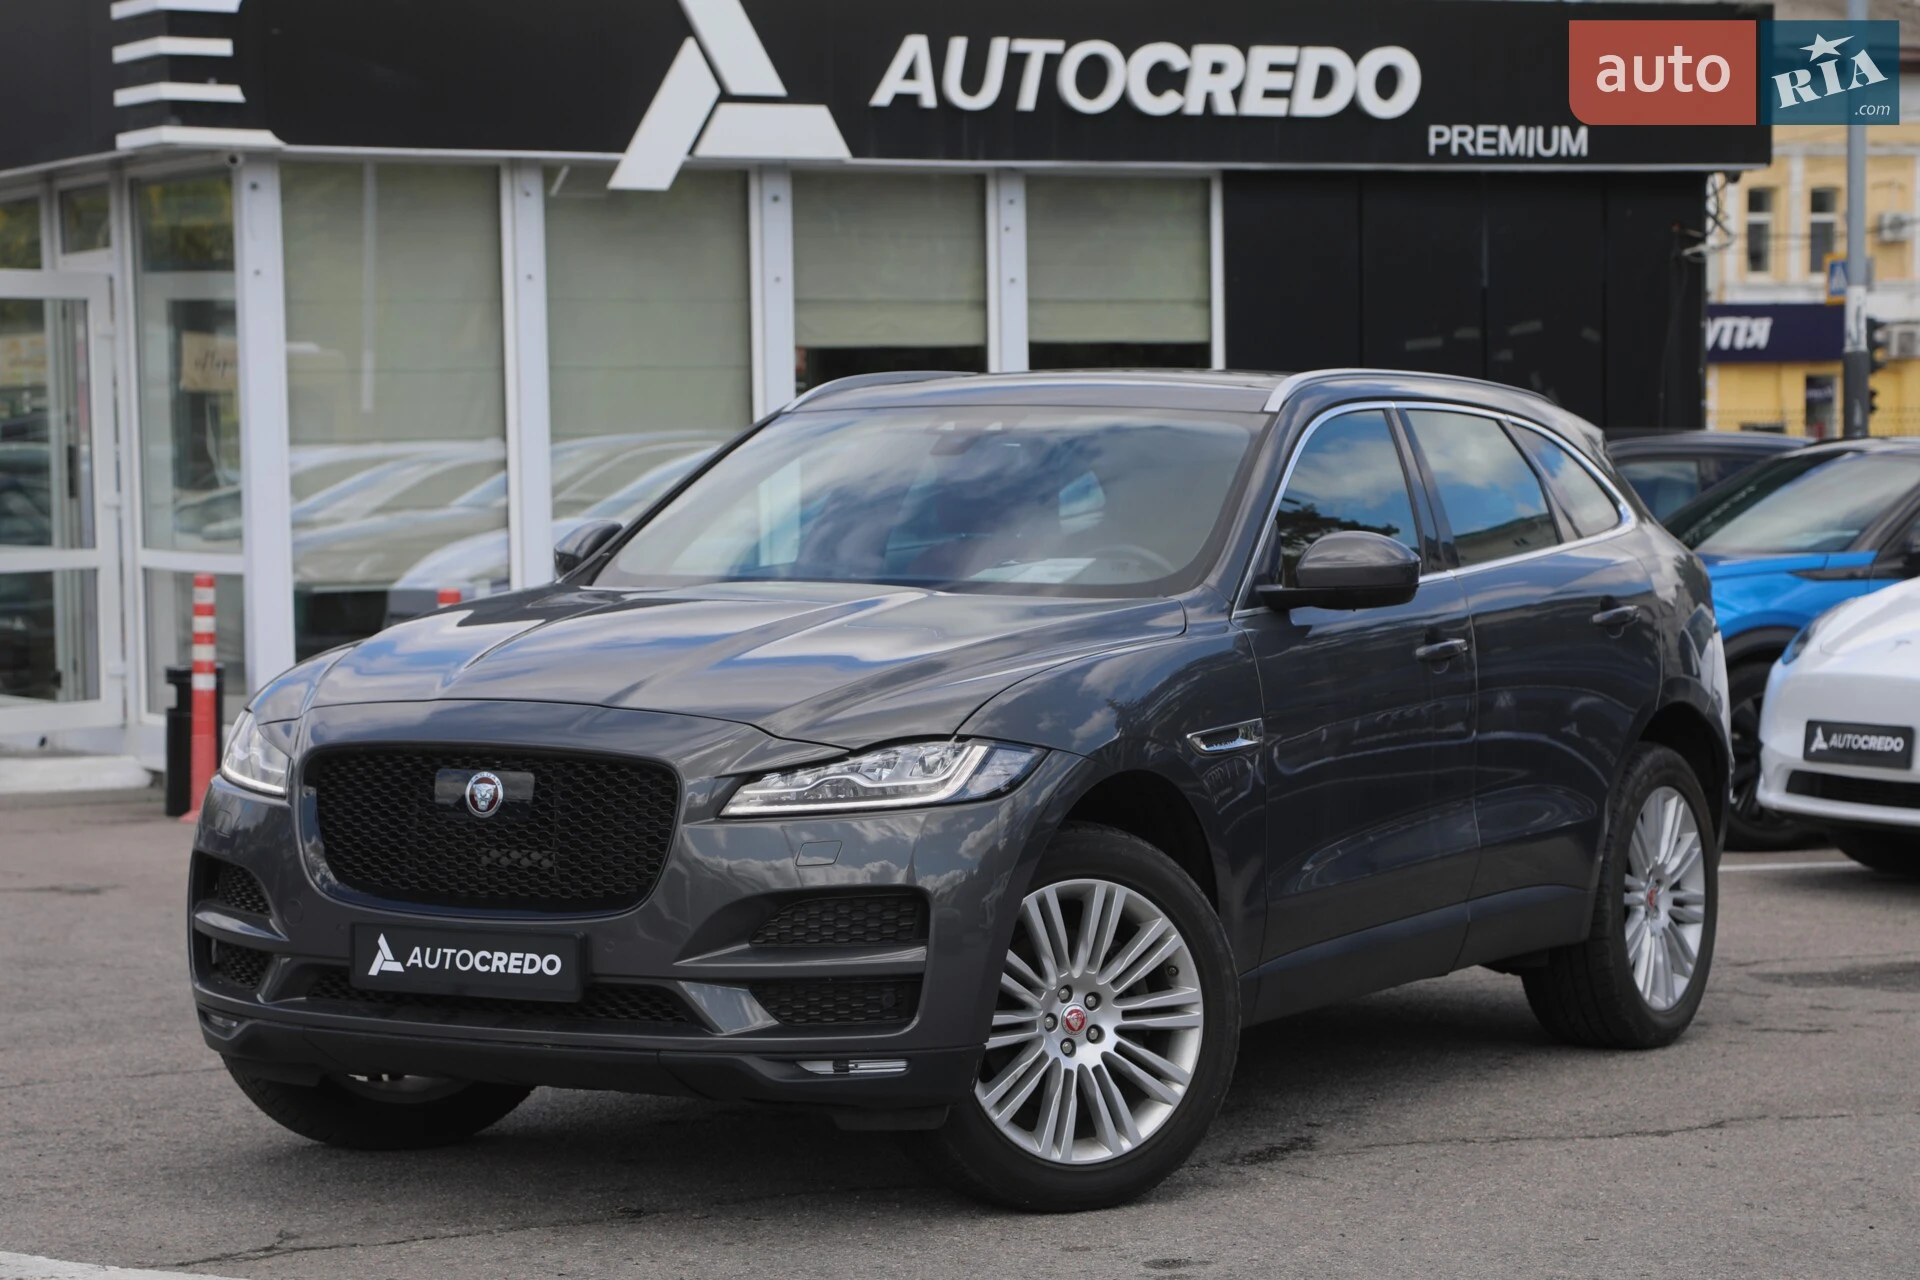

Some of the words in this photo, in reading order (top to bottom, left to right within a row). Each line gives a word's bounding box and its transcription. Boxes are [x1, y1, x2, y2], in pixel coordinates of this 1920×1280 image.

[870, 33, 1422, 119] AUTOCREDO
[1427, 125, 1589, 157] PREMIUM
[1829, 733, 1904, 752] AUTOCREDO
[406, 946, 562, 976] AUTOCREDO
